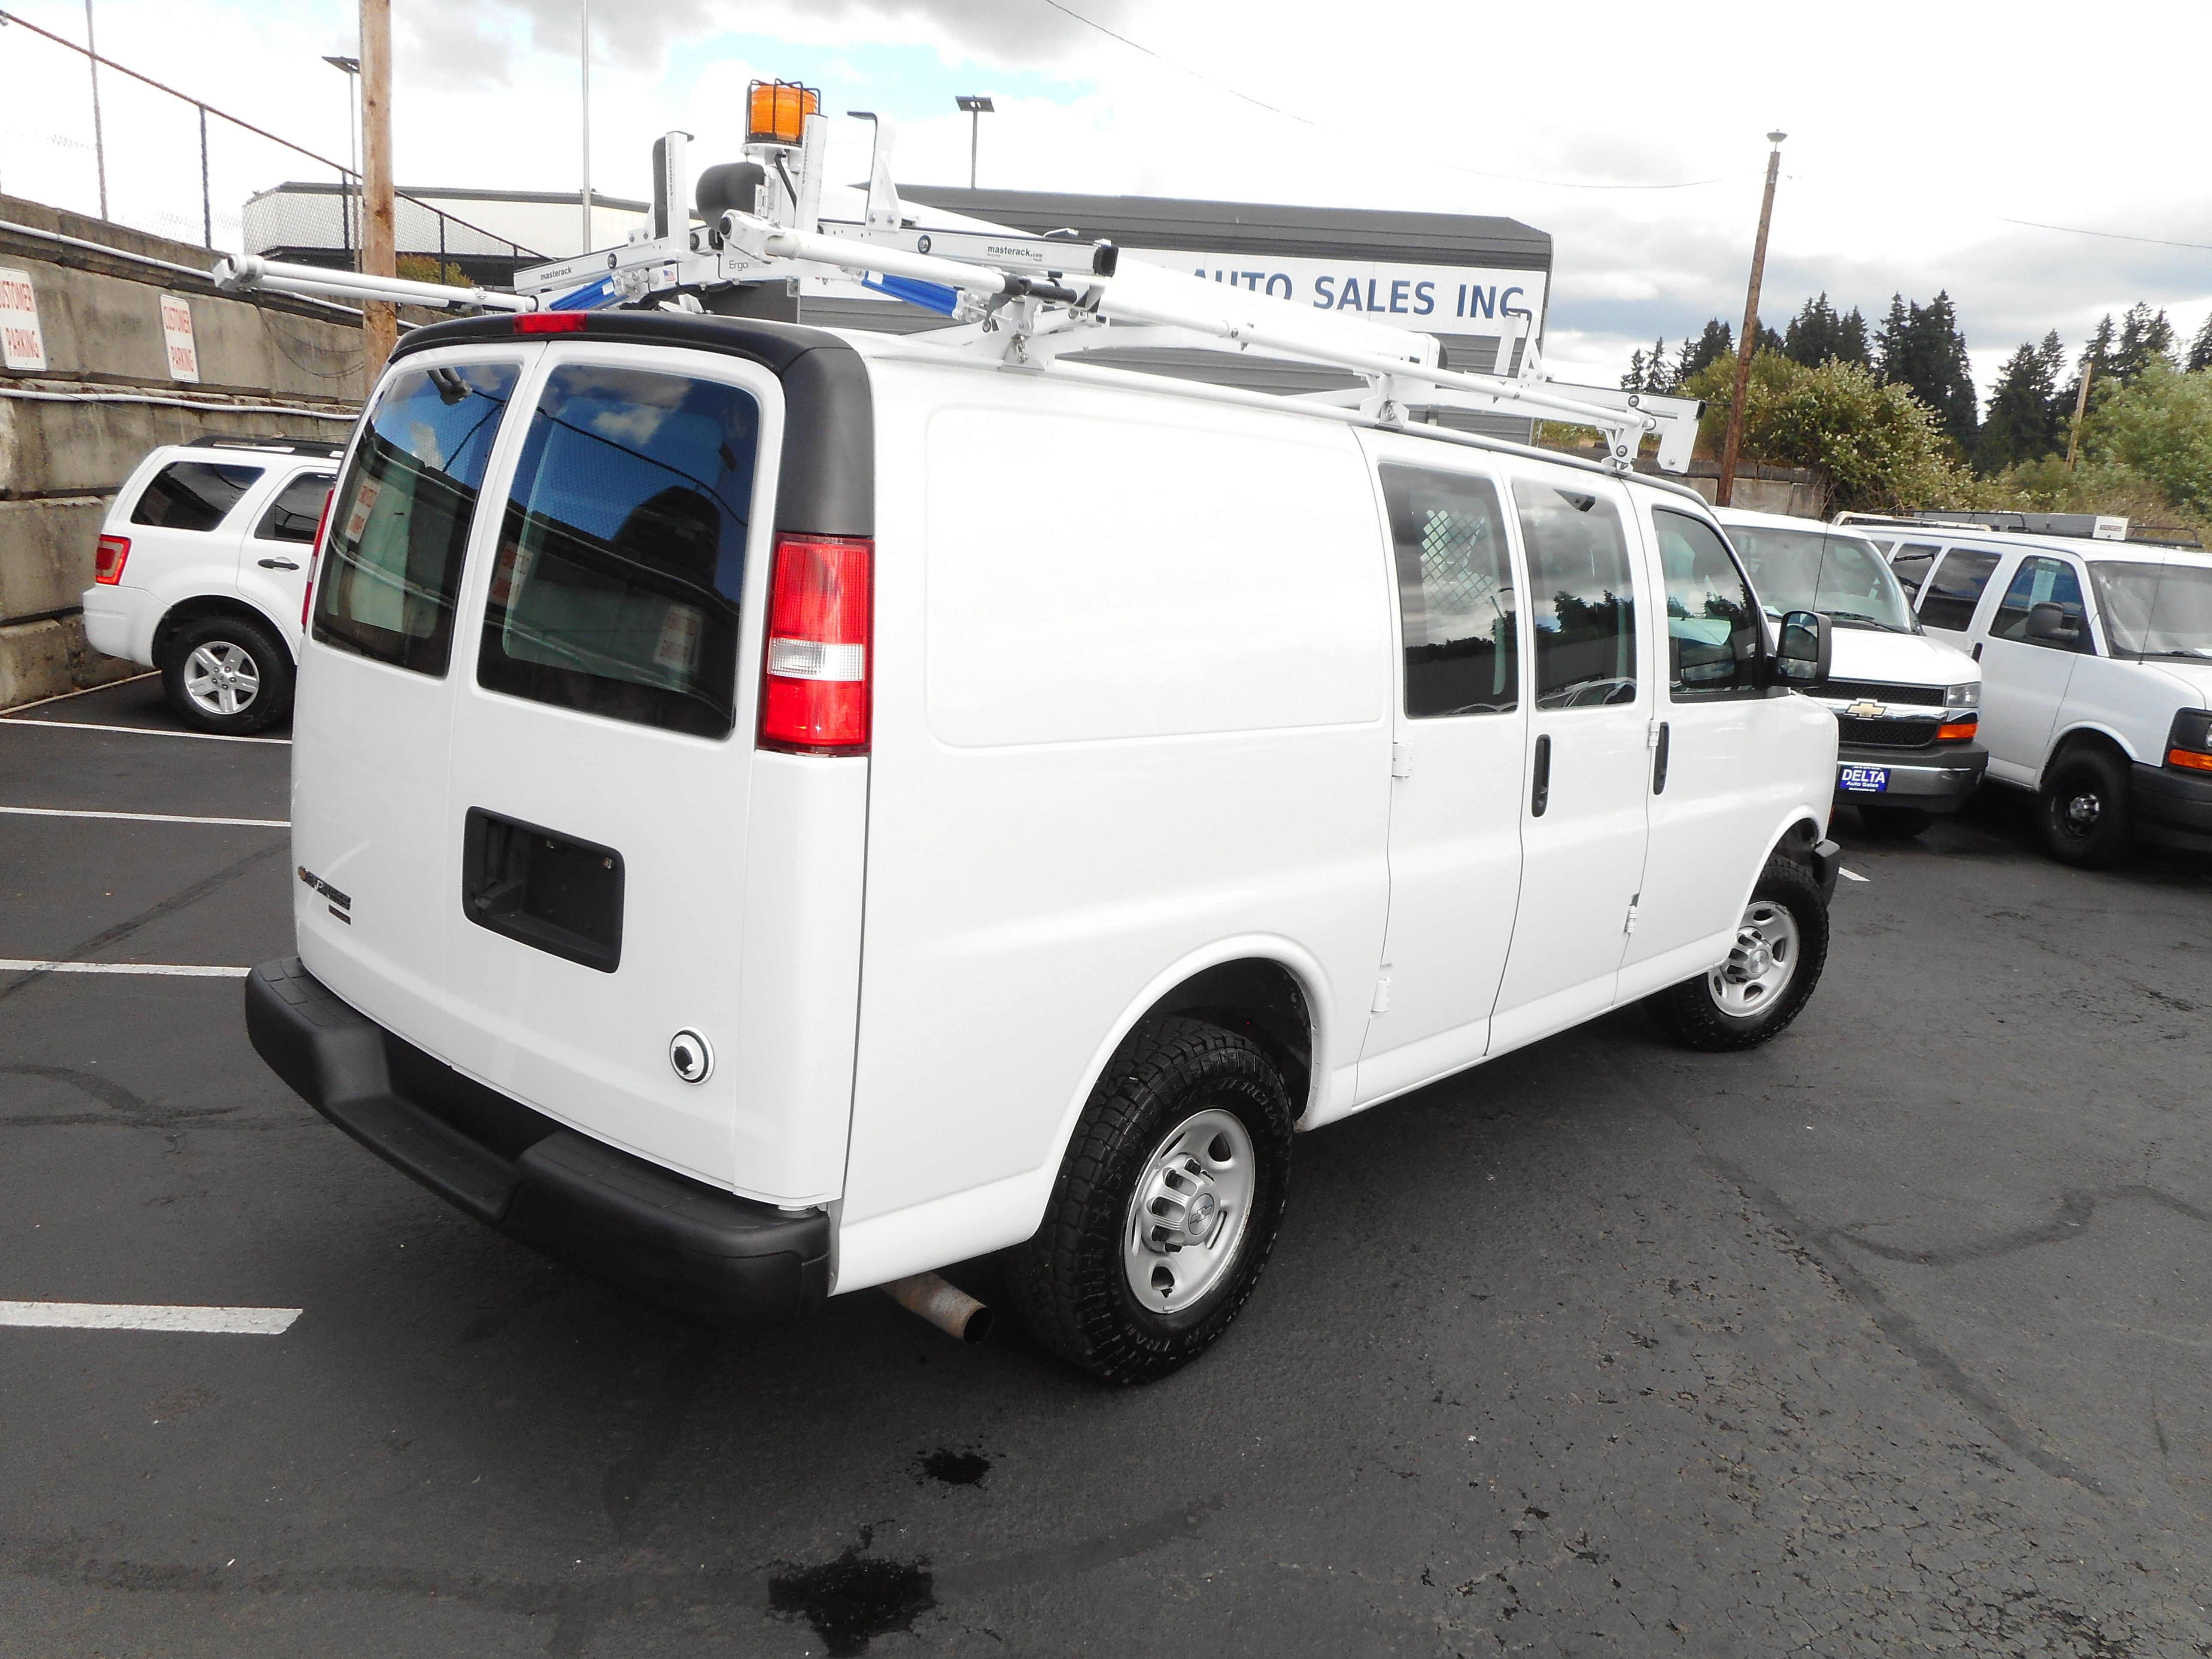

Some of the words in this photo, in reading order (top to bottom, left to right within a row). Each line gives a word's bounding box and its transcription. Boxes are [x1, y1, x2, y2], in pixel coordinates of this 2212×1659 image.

[729, 260, 748, 271] Ergo
[540, 266, 572, 280] masterack
[1194, 268, 1293, 301] TO
[1313, 276, 1435, 315] SALES
[1456, 283, 1525, 319] INC
[1841, 769, 1885, 784] DELTA
